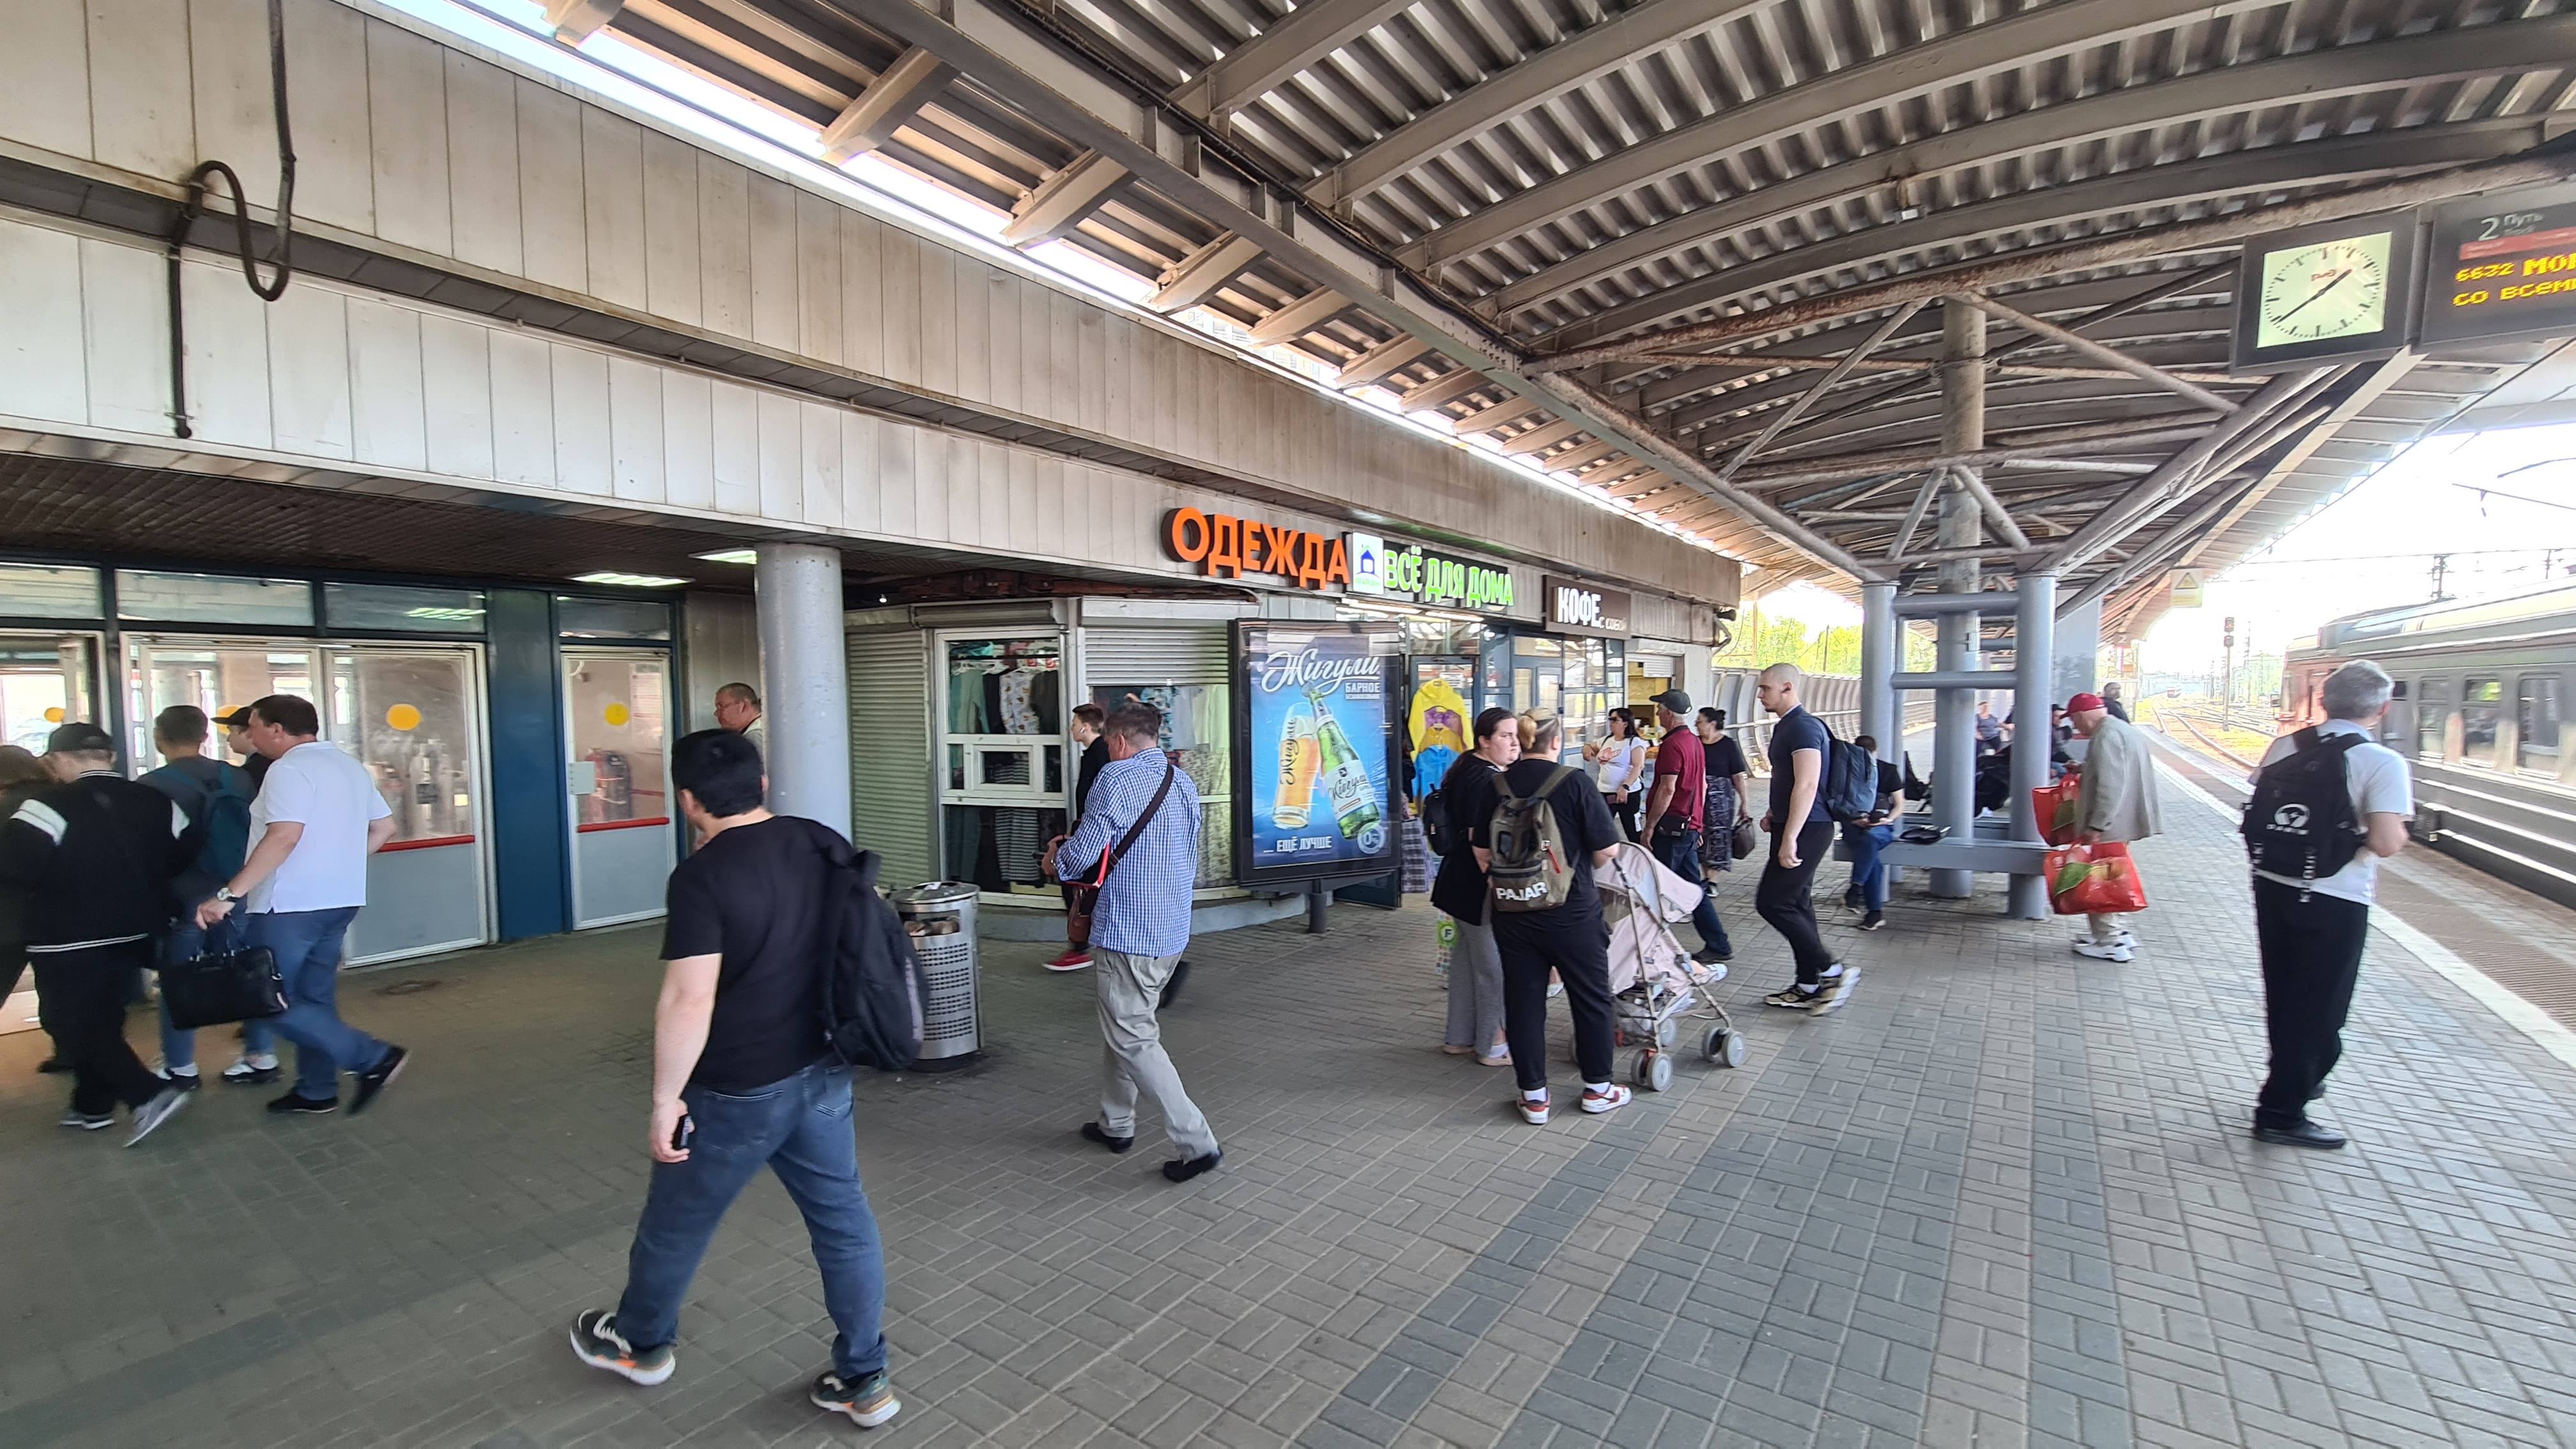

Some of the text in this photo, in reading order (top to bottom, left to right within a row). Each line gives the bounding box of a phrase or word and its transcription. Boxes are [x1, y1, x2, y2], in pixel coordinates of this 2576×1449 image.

[2478, 217, 2501, 241] 2
[2453, 290, 2489, 307] СО
[1170, 506, 1350, 590] ОДЕЖДА
[1384, 545, 1514, 609] ВСЁ ДЛЯ ДОМА
[1557, 586, 1602, 628] КОФЕ
[1261, 648, 1381, 695] Жигули
[1345, 682, 1381, 693] БАРНОЕ
[1299, 836, 1333, 851] ЛУЧШЕ
[1496, 882, 1548, 901] PAJAR
